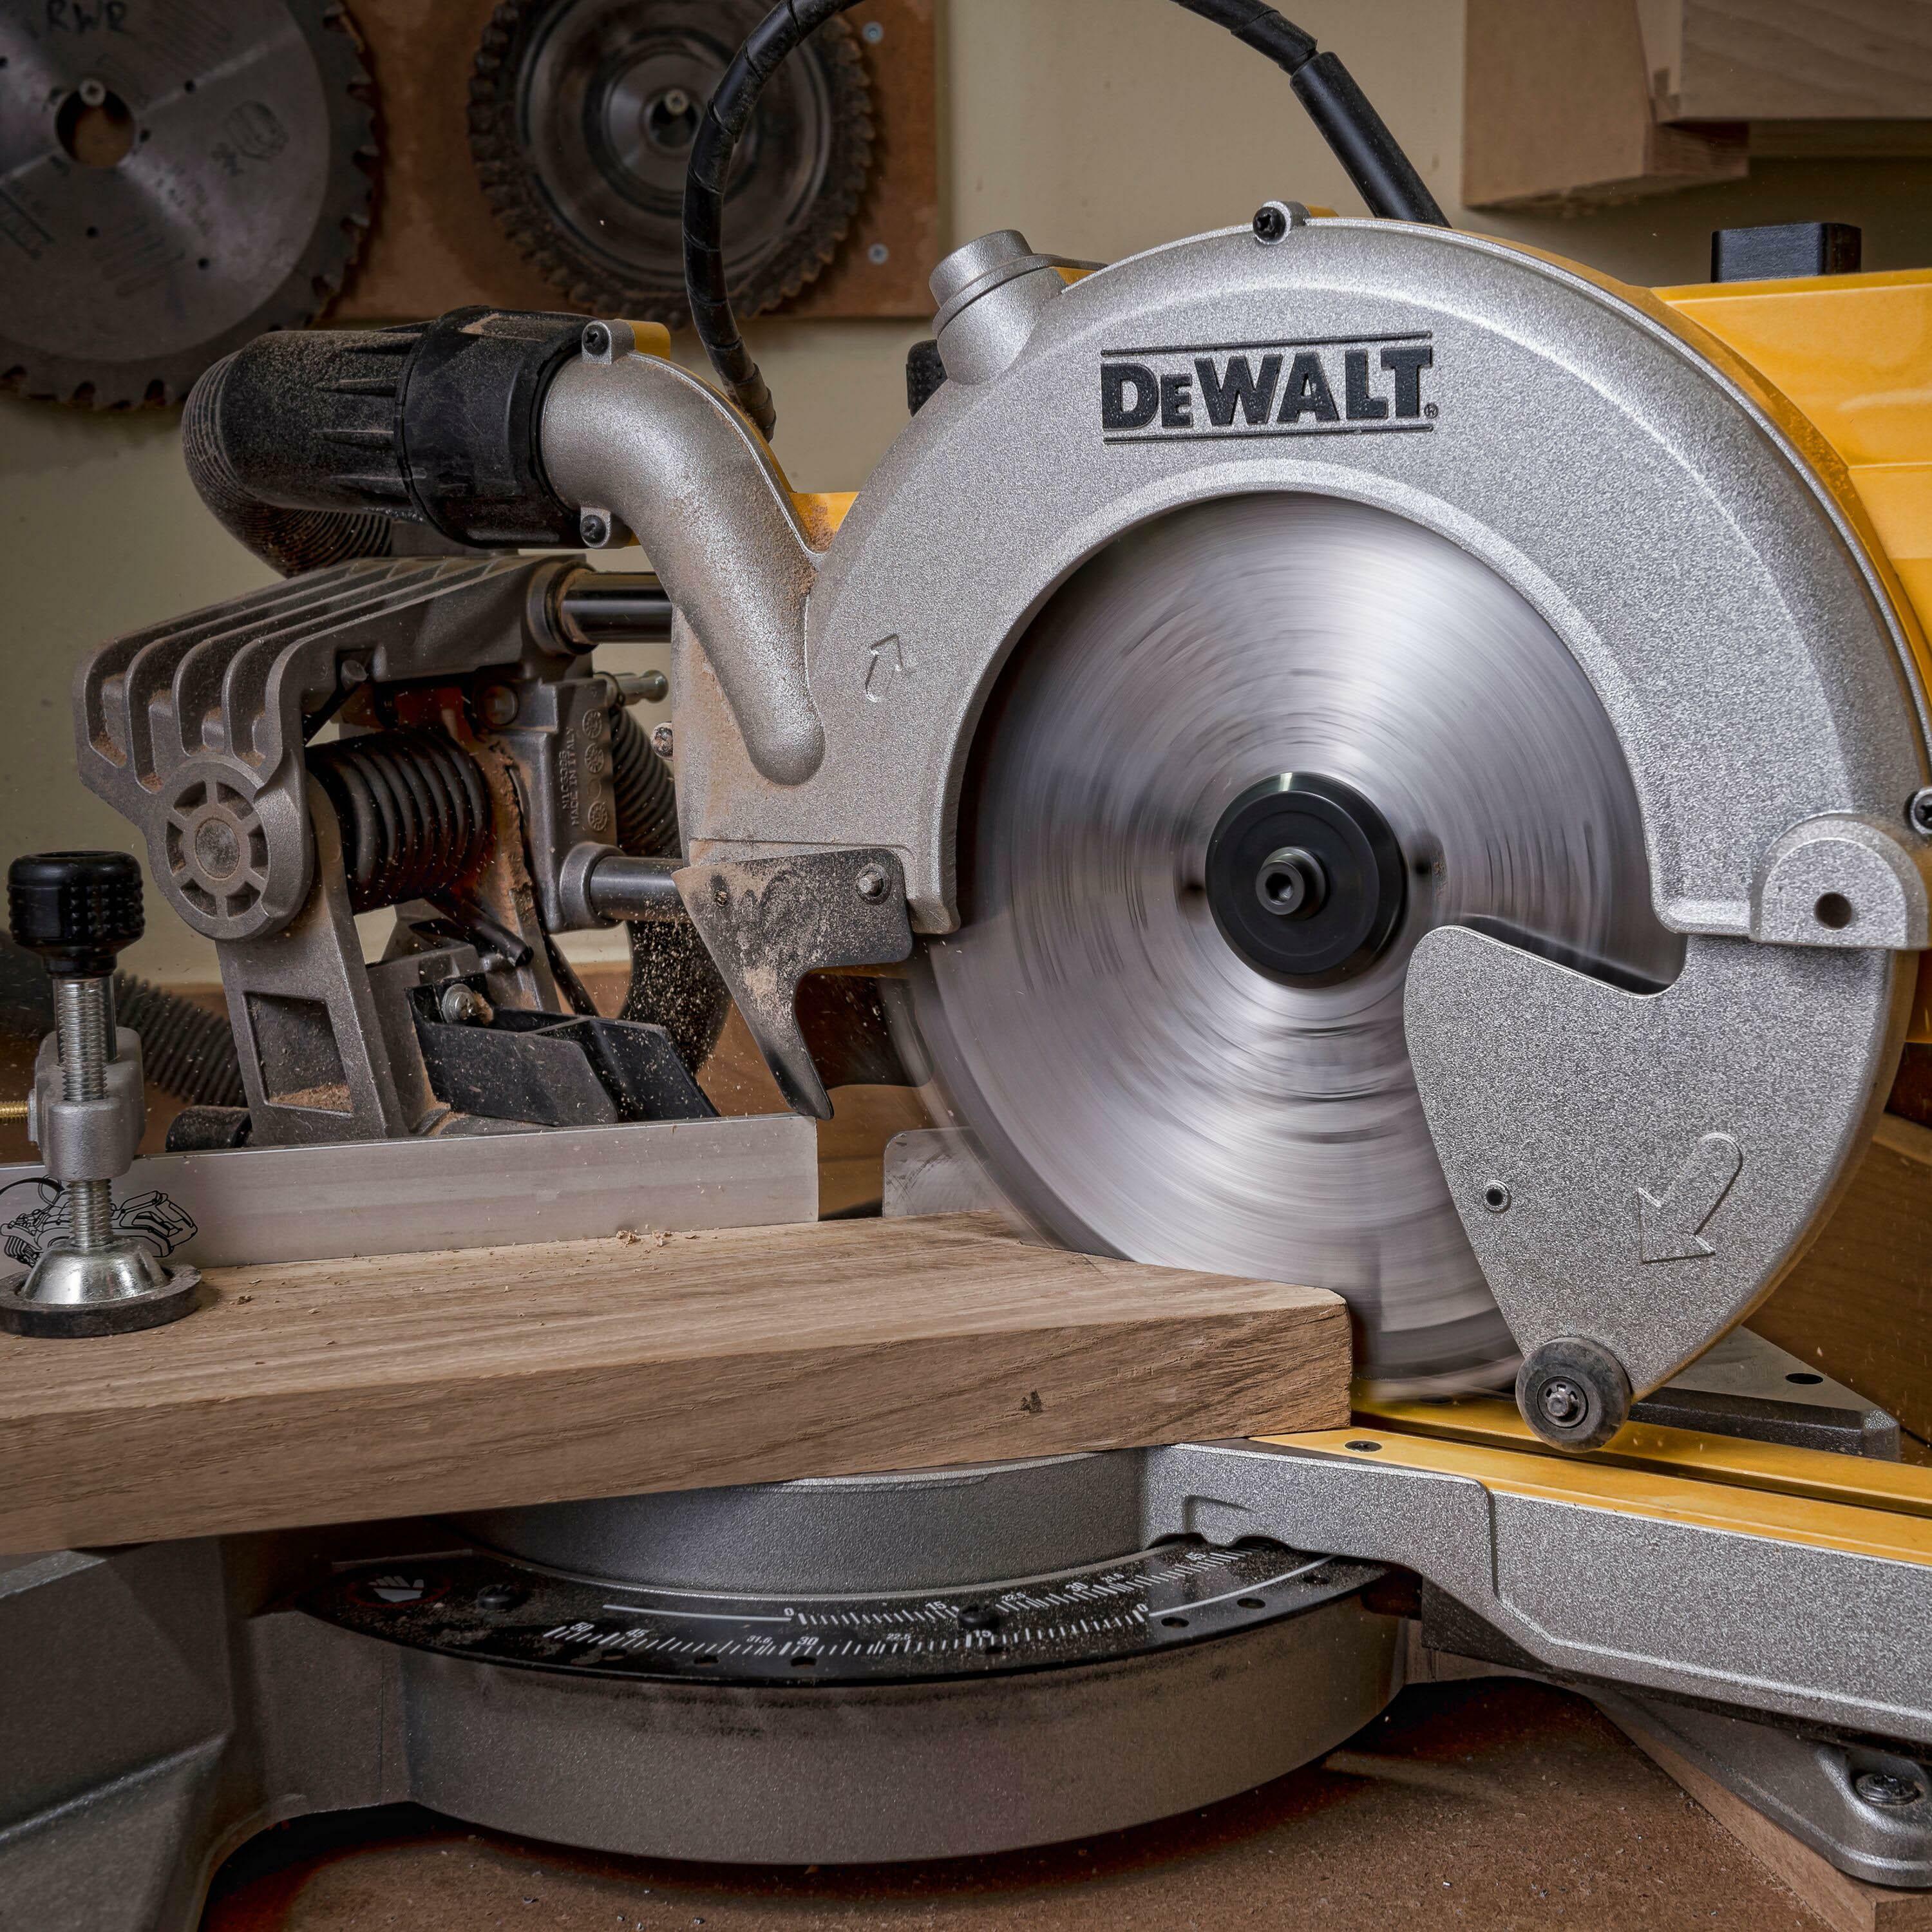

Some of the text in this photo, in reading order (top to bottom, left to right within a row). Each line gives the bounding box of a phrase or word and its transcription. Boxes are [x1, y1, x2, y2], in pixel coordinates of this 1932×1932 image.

[566, 726, 580, 826] MADE IN ITALY
[784, 1607, 795, 1616] 0
[925, 1600, 947, 1610] 15
[1065, 1582, 1088, 1592] 30
[1185, 1552, 1207, 1561] 45
[797, 1636, 820, 1645] 30
[974, 1629, 992, 1638] 15
[1136, 1602, 1149, 1612] 0
